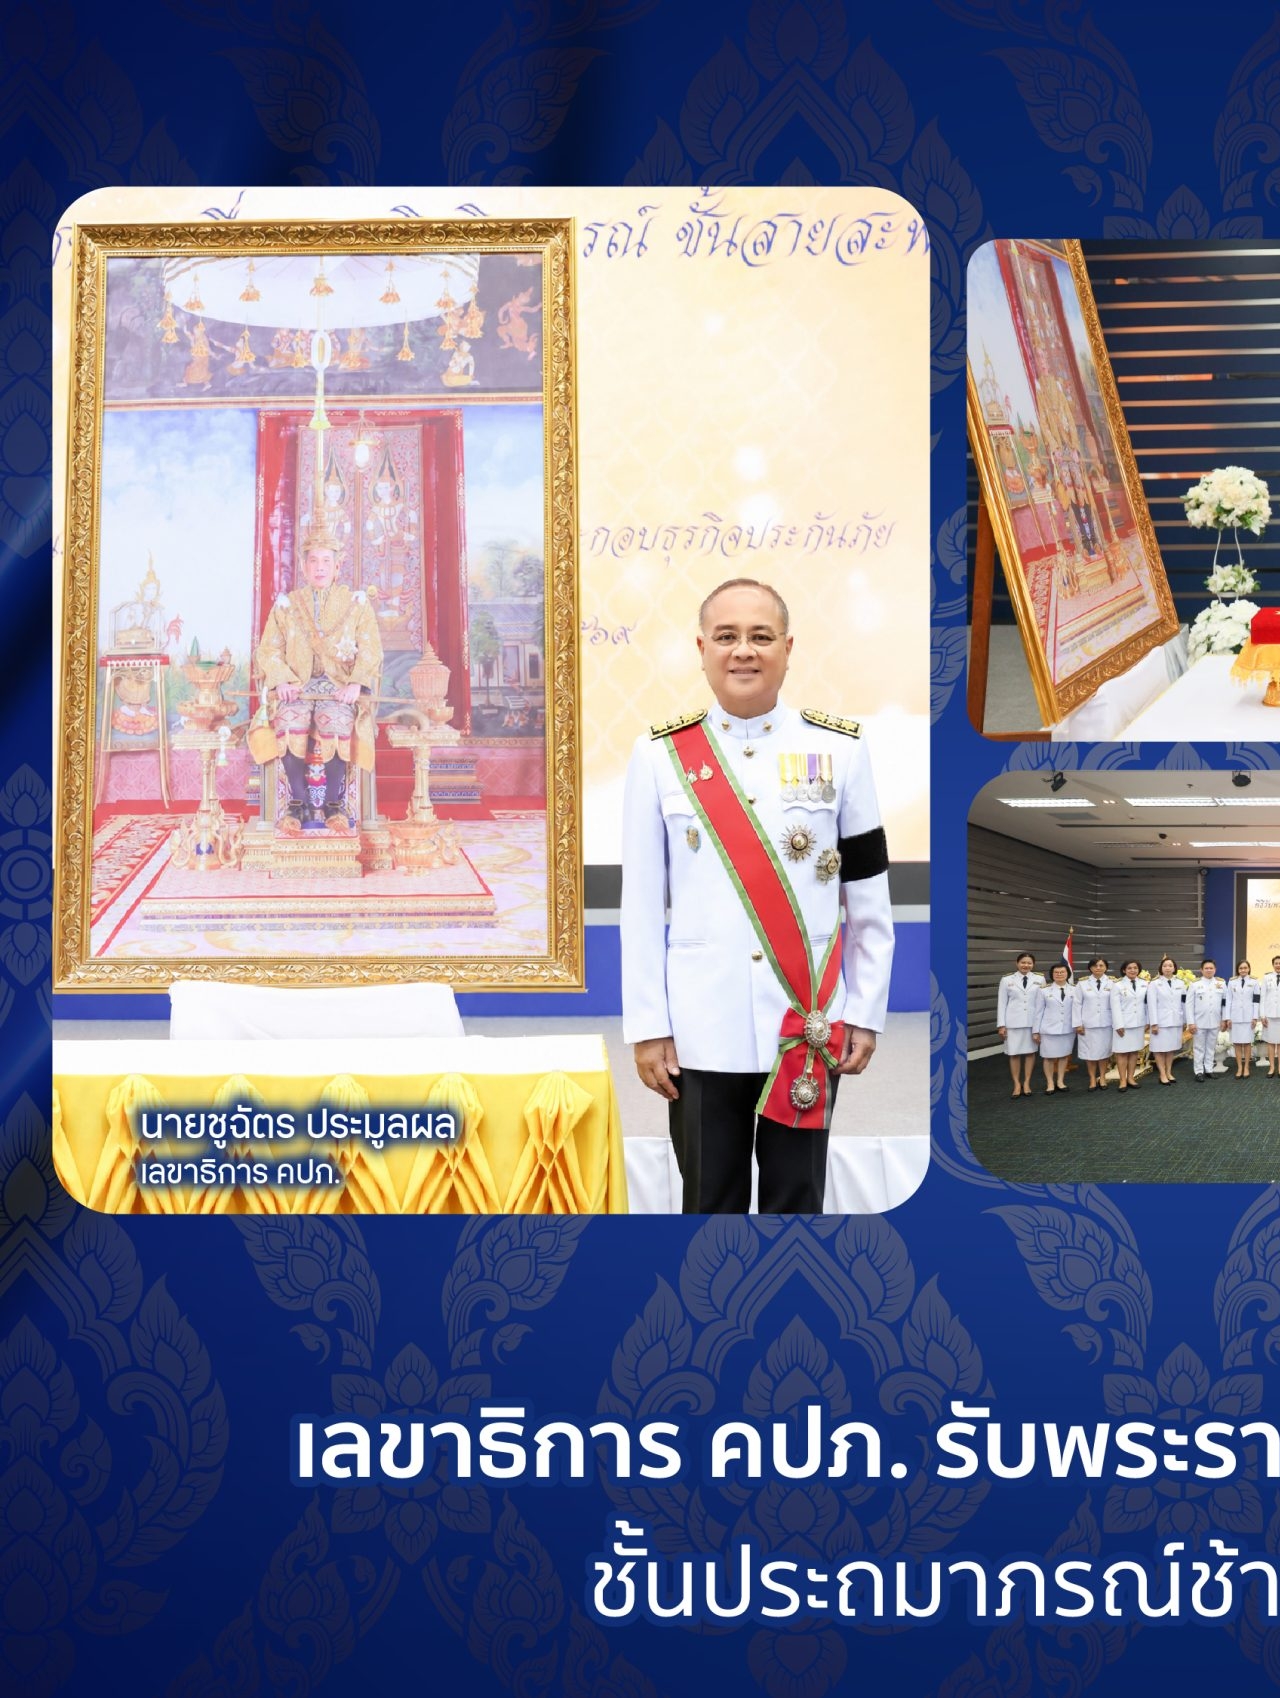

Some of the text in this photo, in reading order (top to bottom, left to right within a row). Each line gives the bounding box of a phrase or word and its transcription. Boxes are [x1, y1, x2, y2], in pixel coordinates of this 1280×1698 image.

[580, 508, 898, 568] กอบธุรกิจประกันภัย
